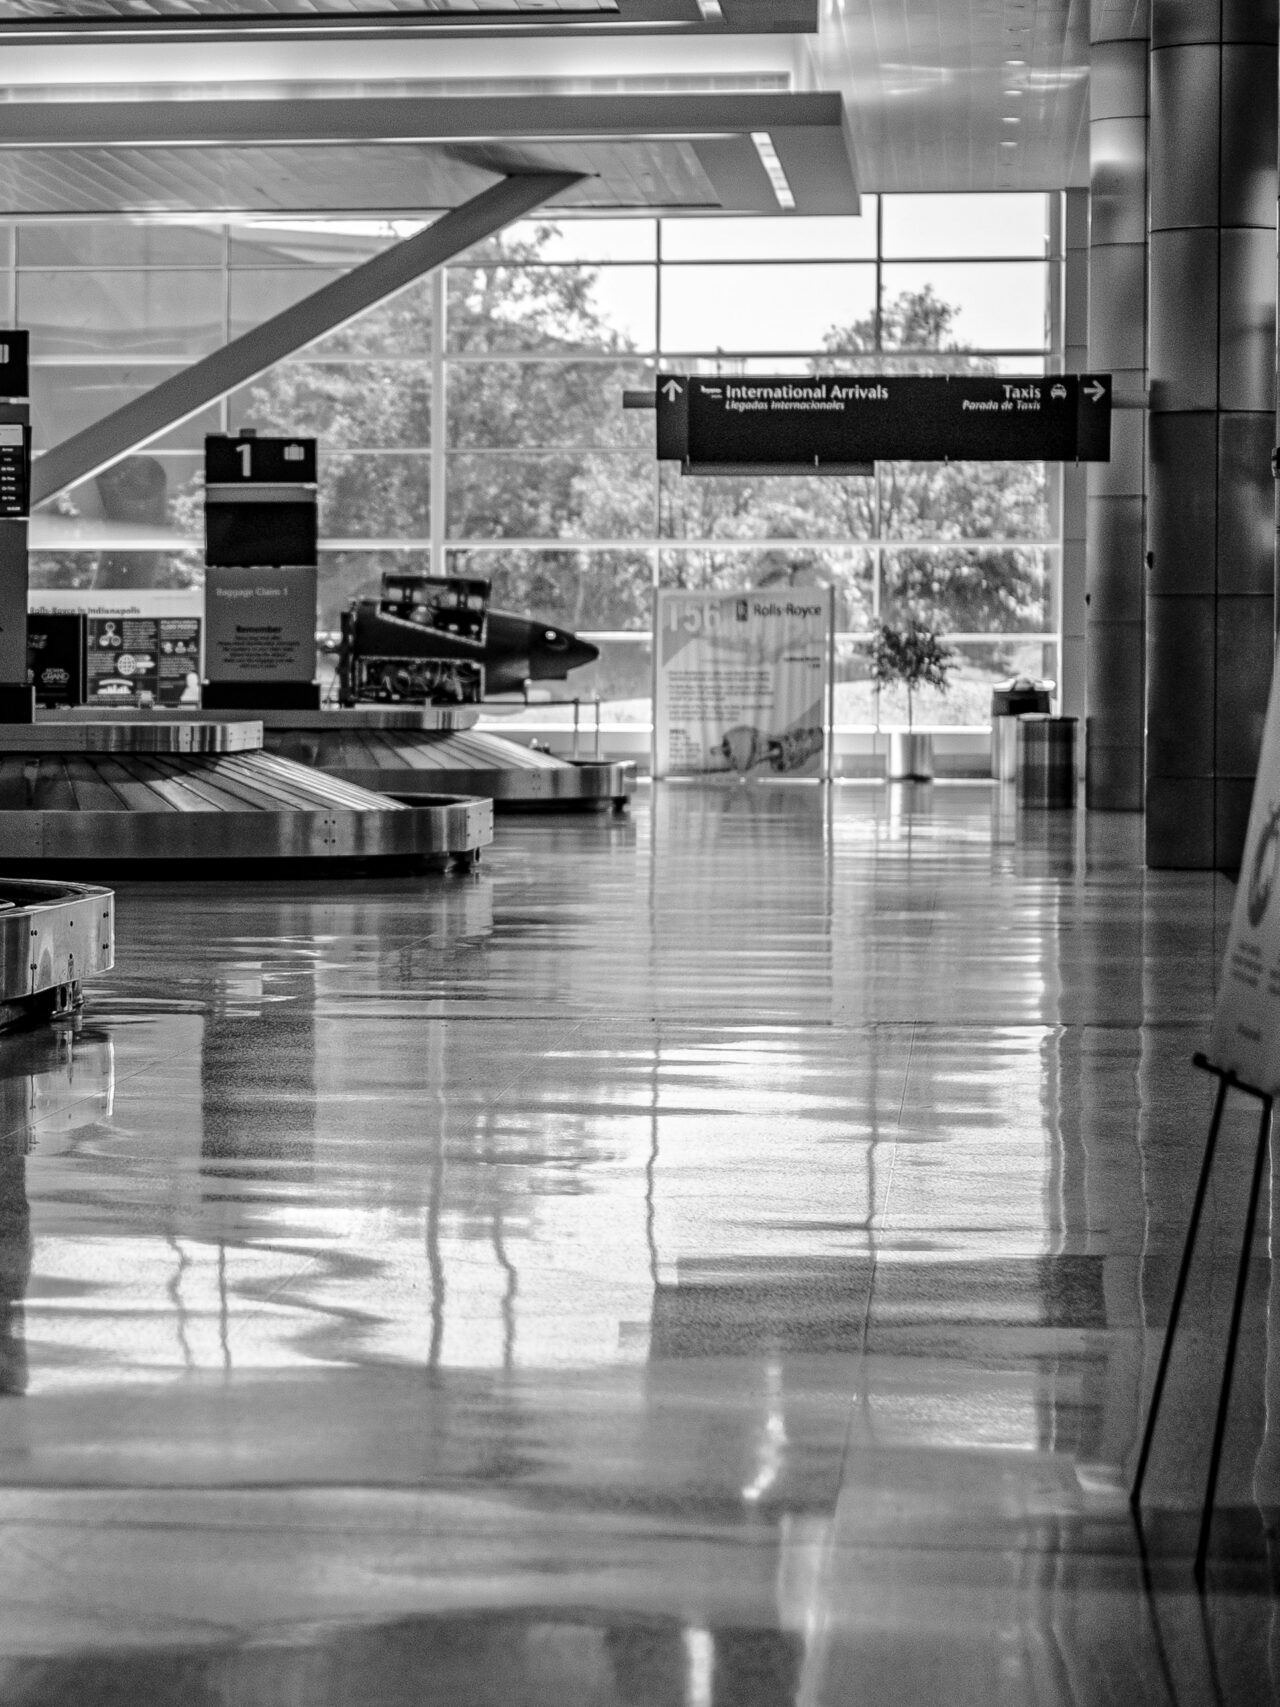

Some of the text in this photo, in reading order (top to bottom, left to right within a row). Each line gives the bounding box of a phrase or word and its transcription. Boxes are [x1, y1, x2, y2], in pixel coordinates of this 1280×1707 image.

[726, 384, 889, 399] International Arrivals
[1002, 384, 1041, 399] Taxis
[725, 400, 845, 412] Llegadas Internacionales
[962, 399, 1041, 411] Parada de Taxis
[235, 443, 251, 477] 1
